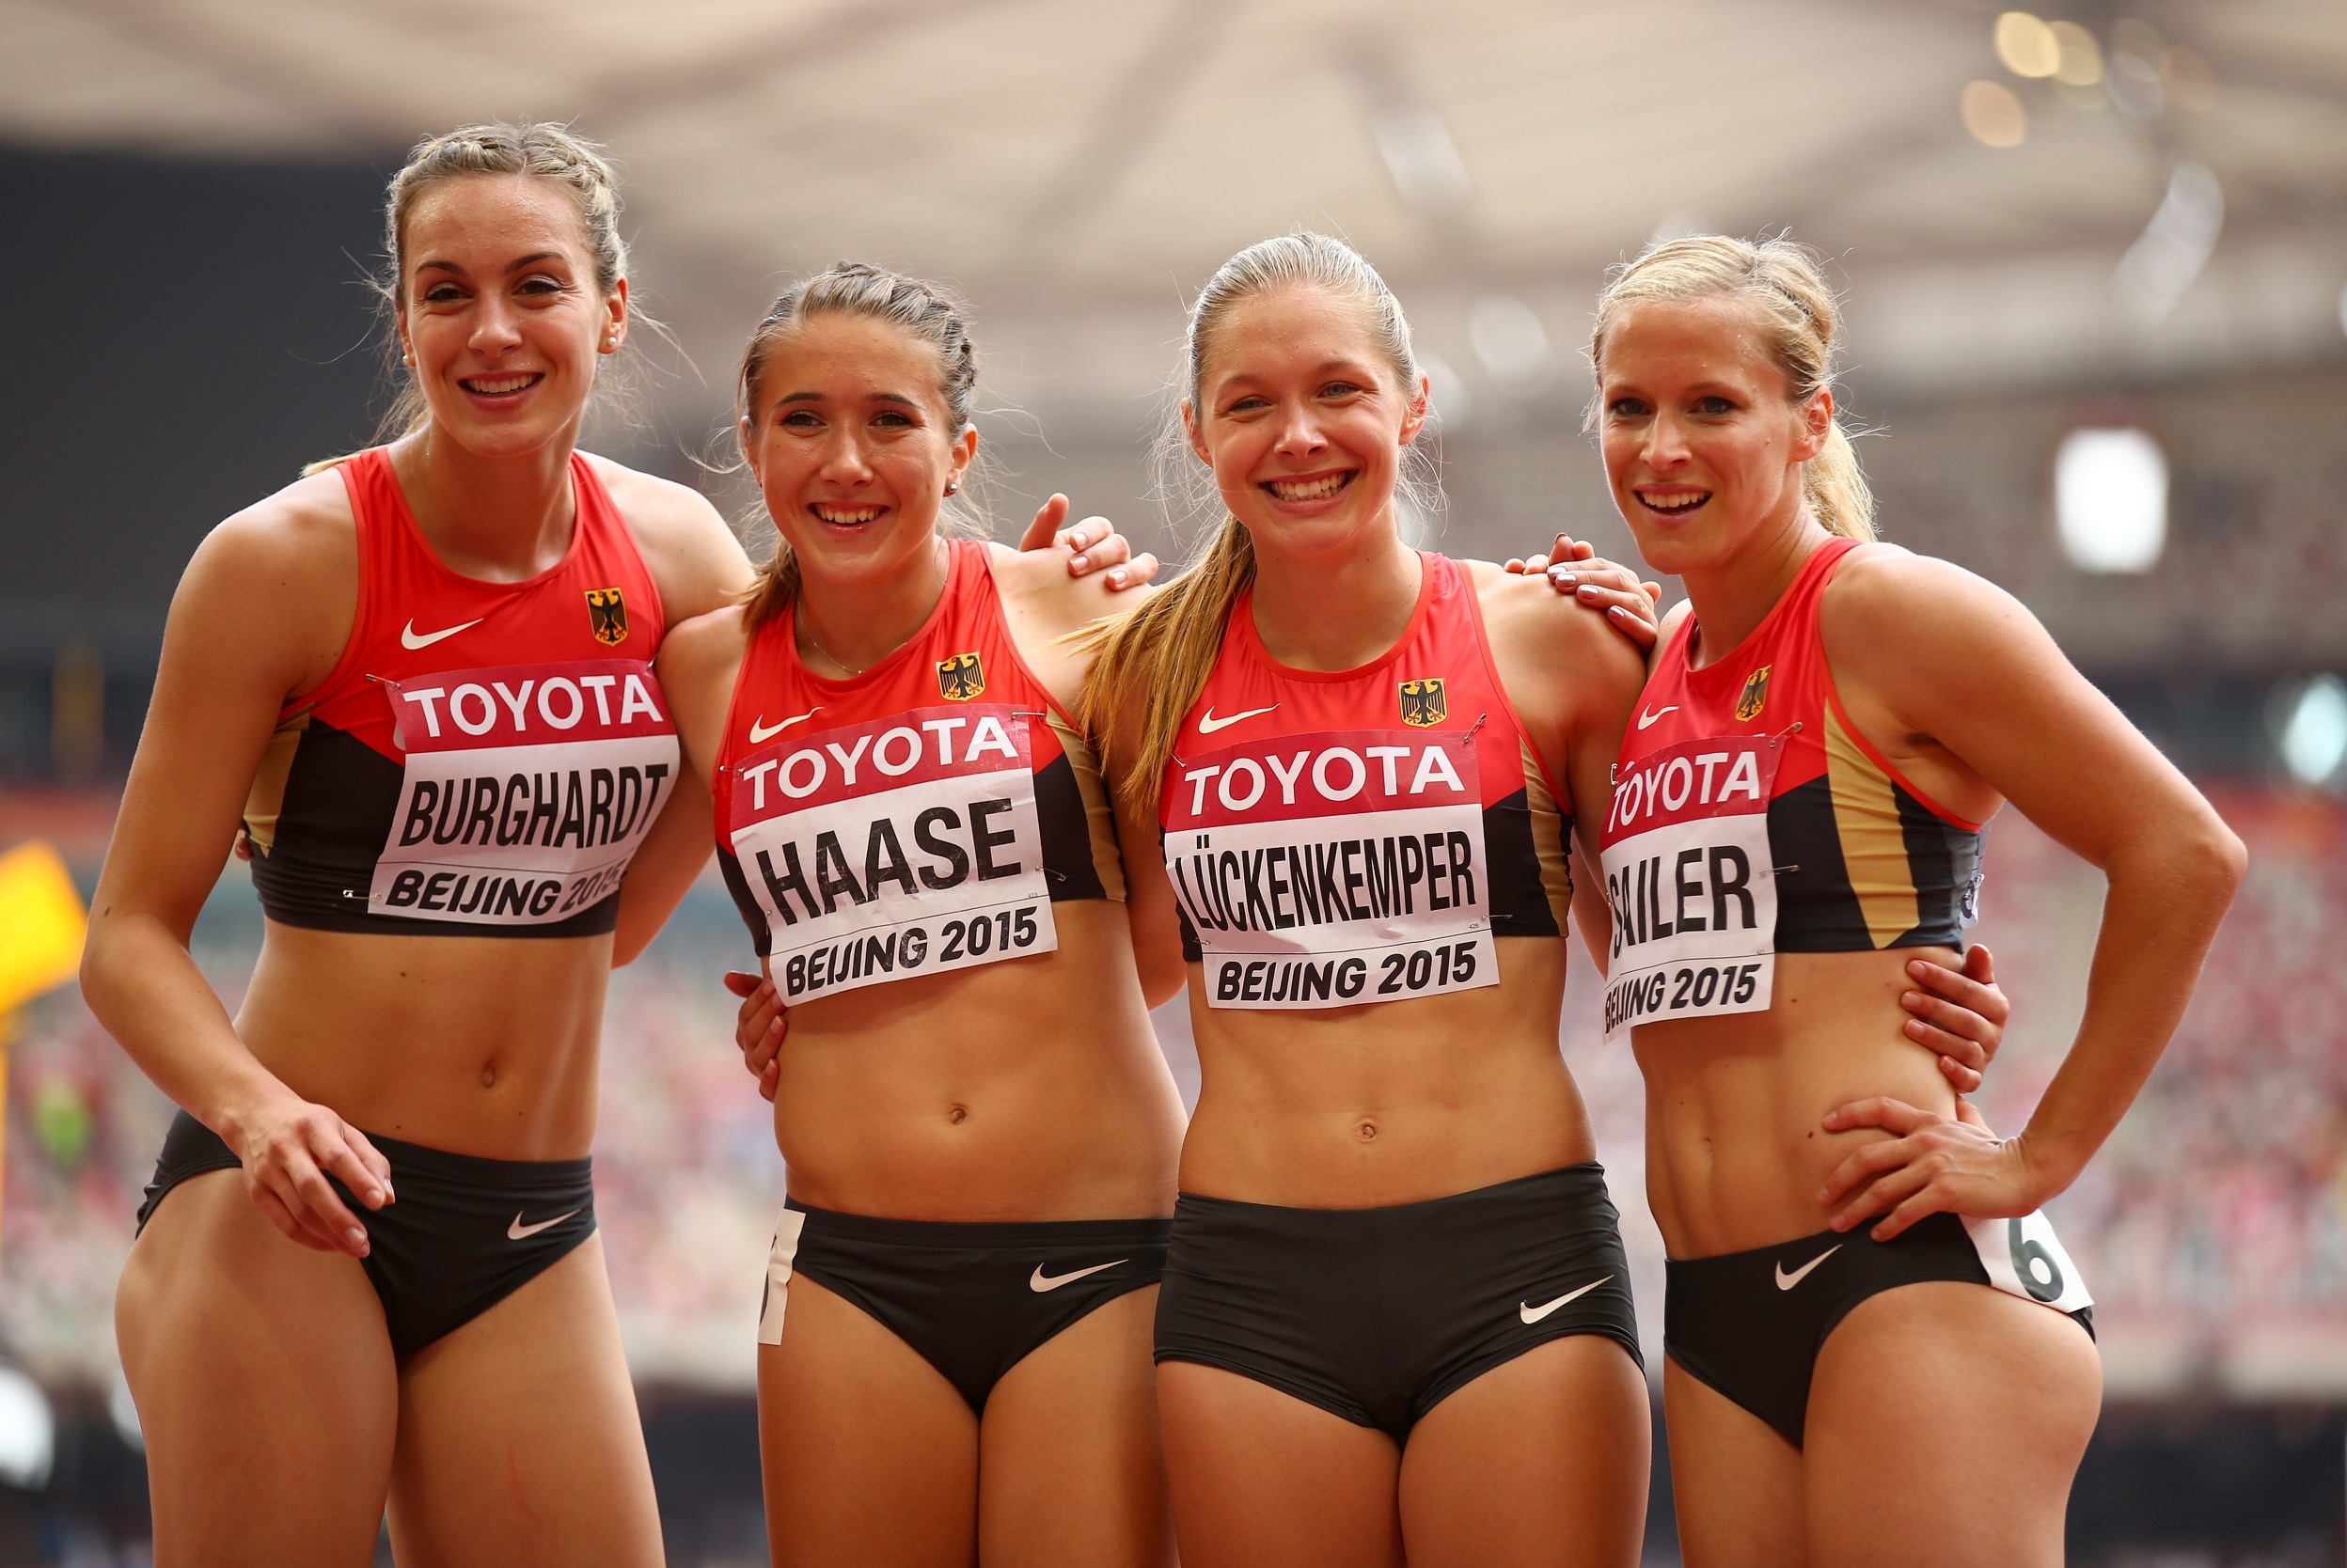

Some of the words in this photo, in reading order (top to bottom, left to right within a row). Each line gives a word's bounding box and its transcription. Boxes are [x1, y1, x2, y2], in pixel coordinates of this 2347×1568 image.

[402, 674, 664, 738] TOYOTA
[743, 716, 1018, 810] TOYOTA
[1183, 745, 1465, 816] TOYOTA
[1608, 751, 1760, 833] TOYOTA
[398, 763, 669, 848] BURGHARDT
[386, 870, 561, 917] BEIJING
[755, 797, 1022, 926] HAASE
[1175, 830, 1477, 932] LÜCKENKEMPER
[1609, 845, 1758, 960] SAILER
[786, 927, 928, 996] BEIJING
[939, 905, 1038, 963] 2015
[1217, 957, 1366, 1002] BEIJING
[1378, 940, 1477, 995] 2015
[1605, 971, 1666, 1034] BEIJING
[1669, 964, 1762, 1011] 2015
[2008, 1218, 2063, 1302] 6
